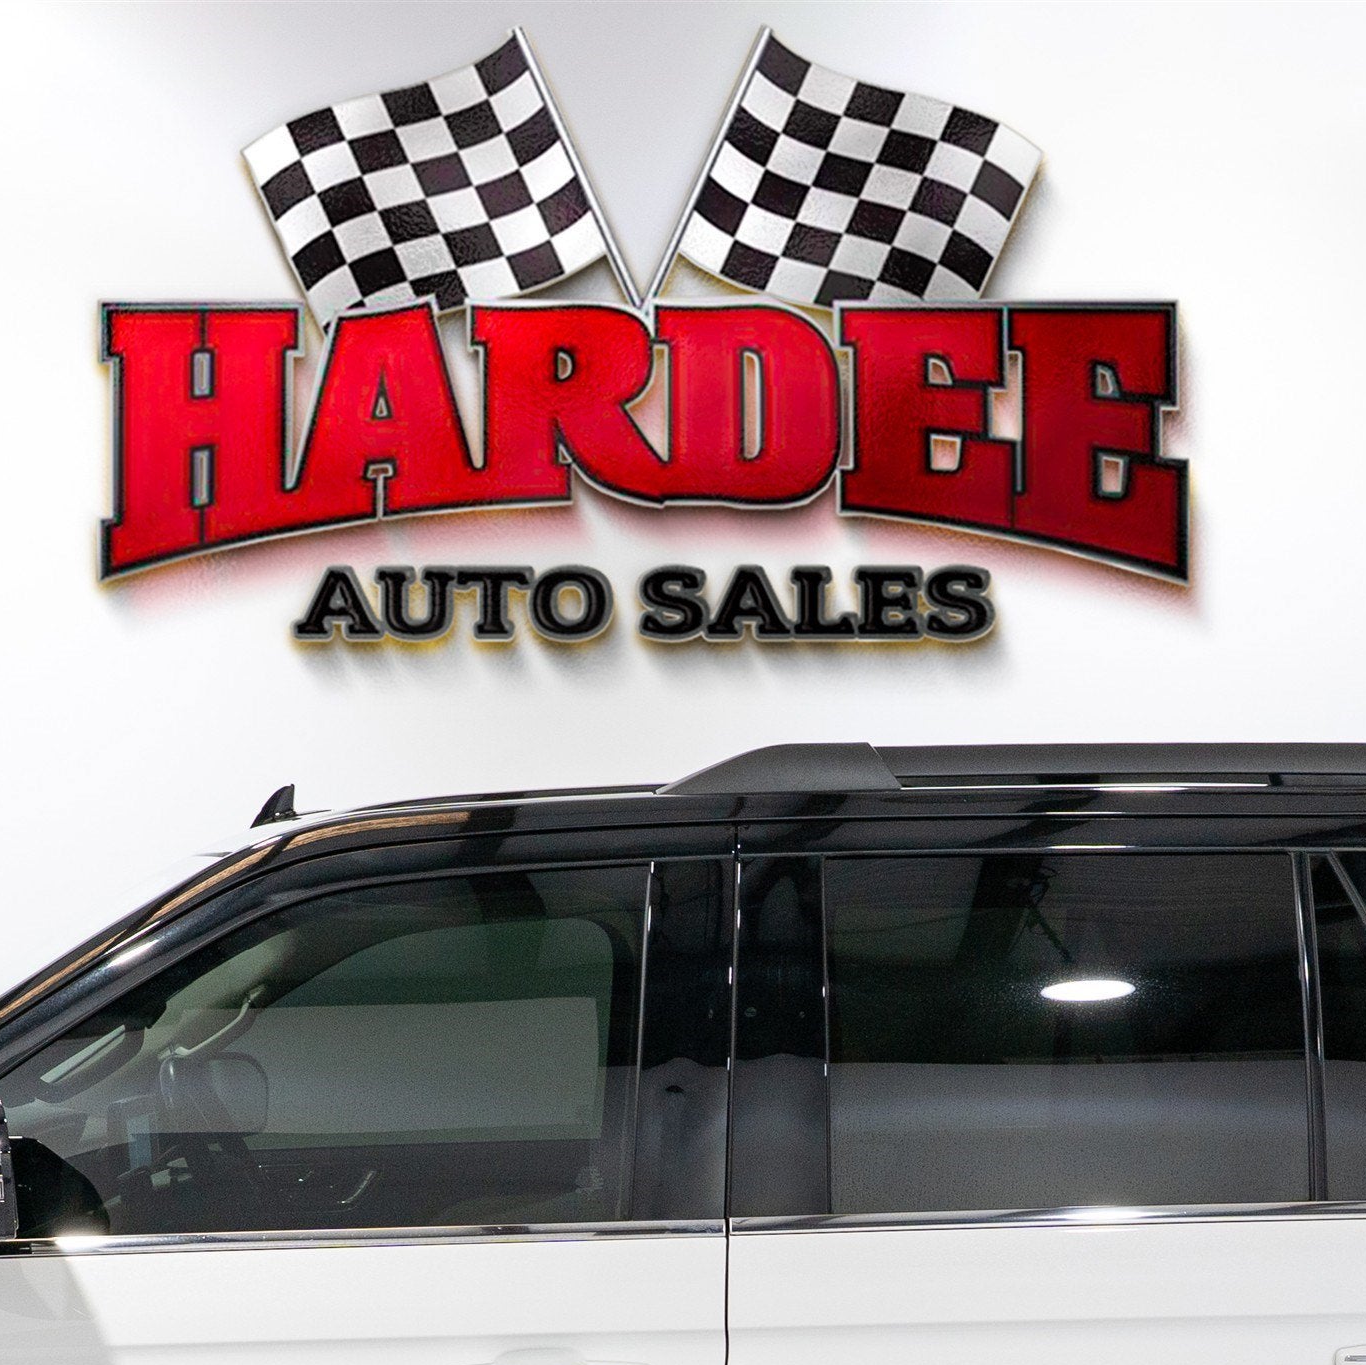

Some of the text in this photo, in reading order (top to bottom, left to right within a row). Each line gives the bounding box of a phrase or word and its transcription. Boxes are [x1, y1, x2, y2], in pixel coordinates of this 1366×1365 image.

[98, 300, 1191, 583] HARDEE
[293, 565, 995, 642] AUTO SALES
